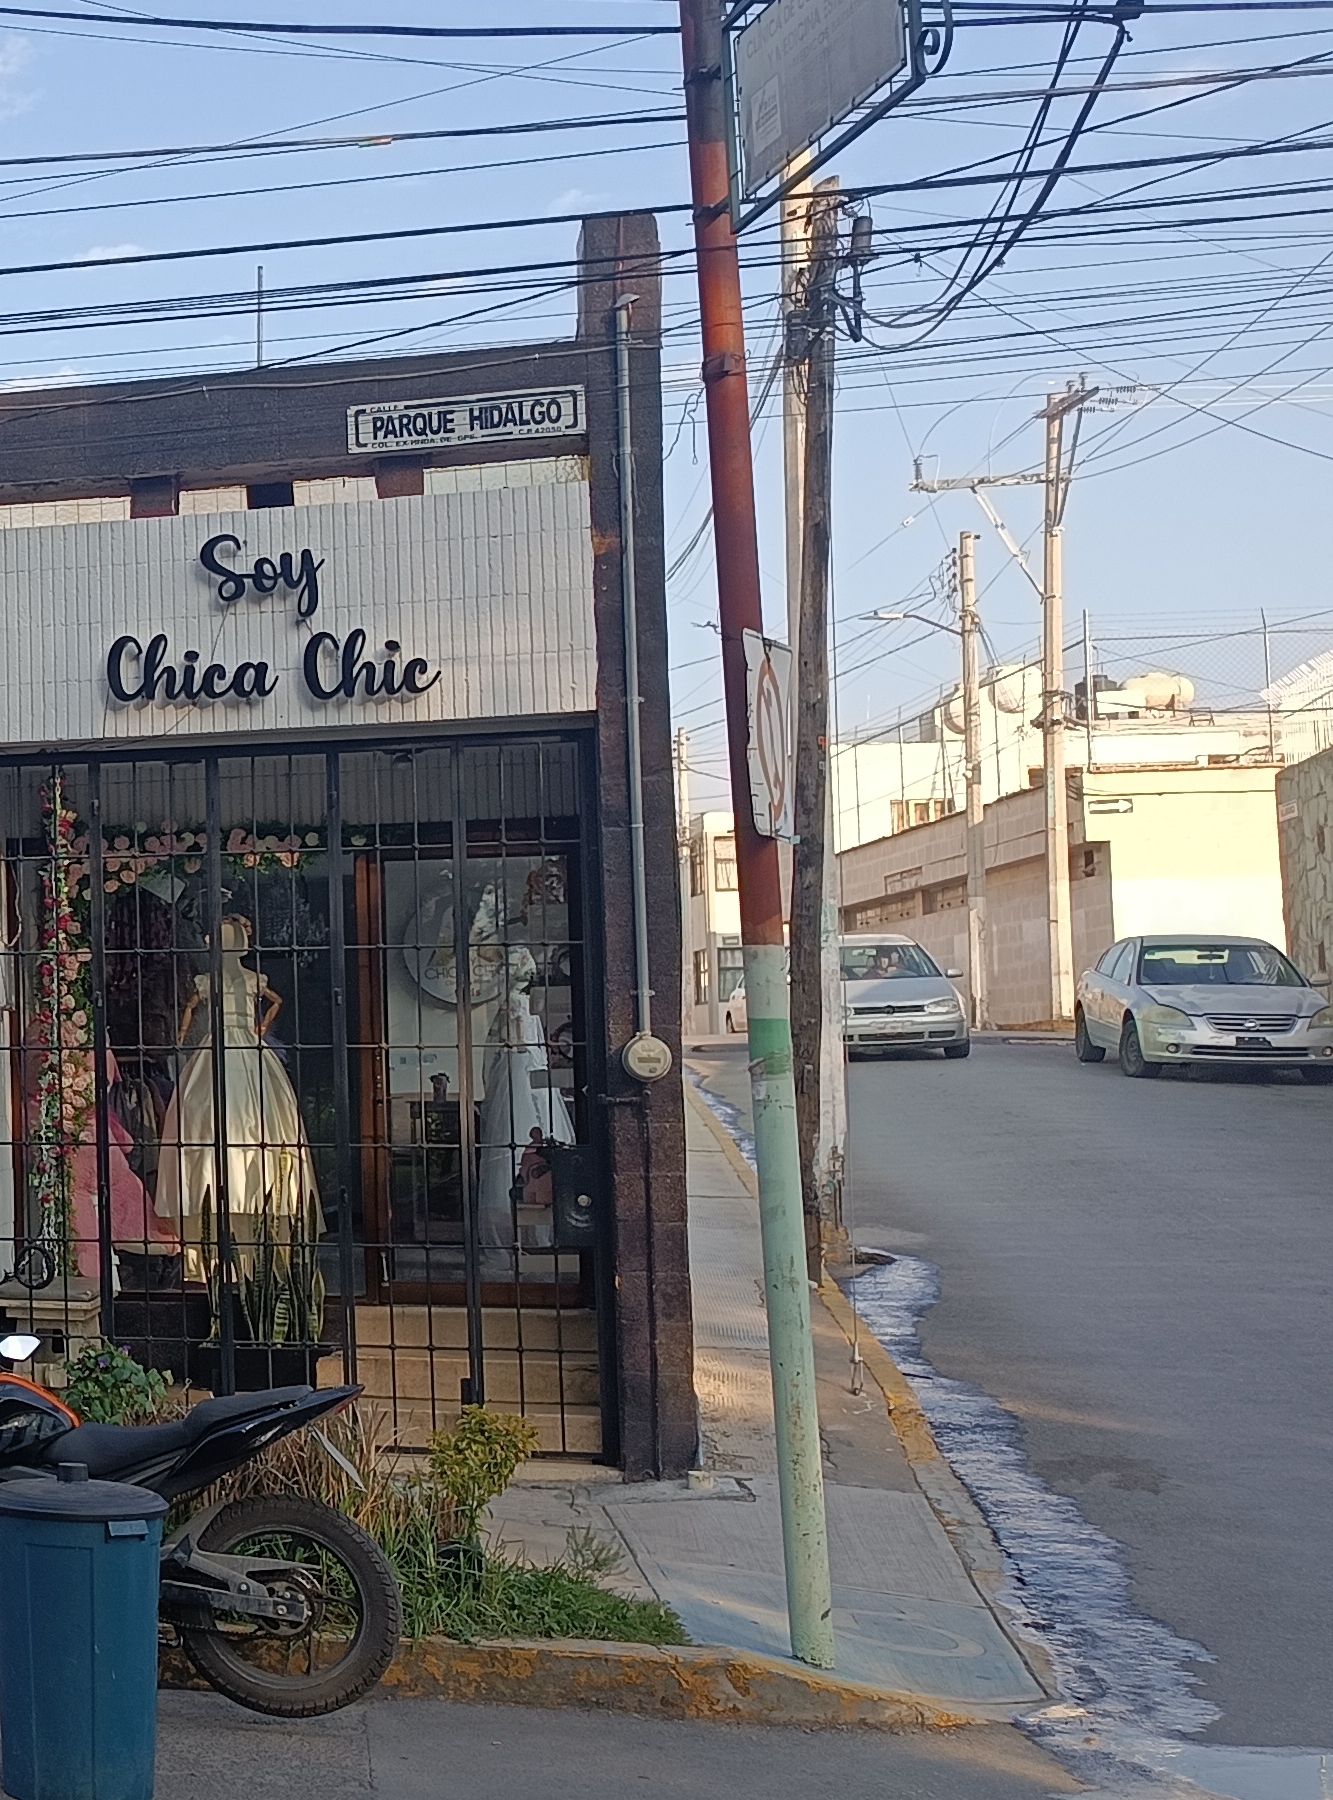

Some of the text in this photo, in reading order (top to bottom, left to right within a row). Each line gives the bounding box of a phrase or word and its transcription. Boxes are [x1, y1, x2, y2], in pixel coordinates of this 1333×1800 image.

[372, 400, 562, 441] PARQUE HIDALGO
[200, 533, 325, 618] Soy
[106, 628, 441, 702] Chica Chic
